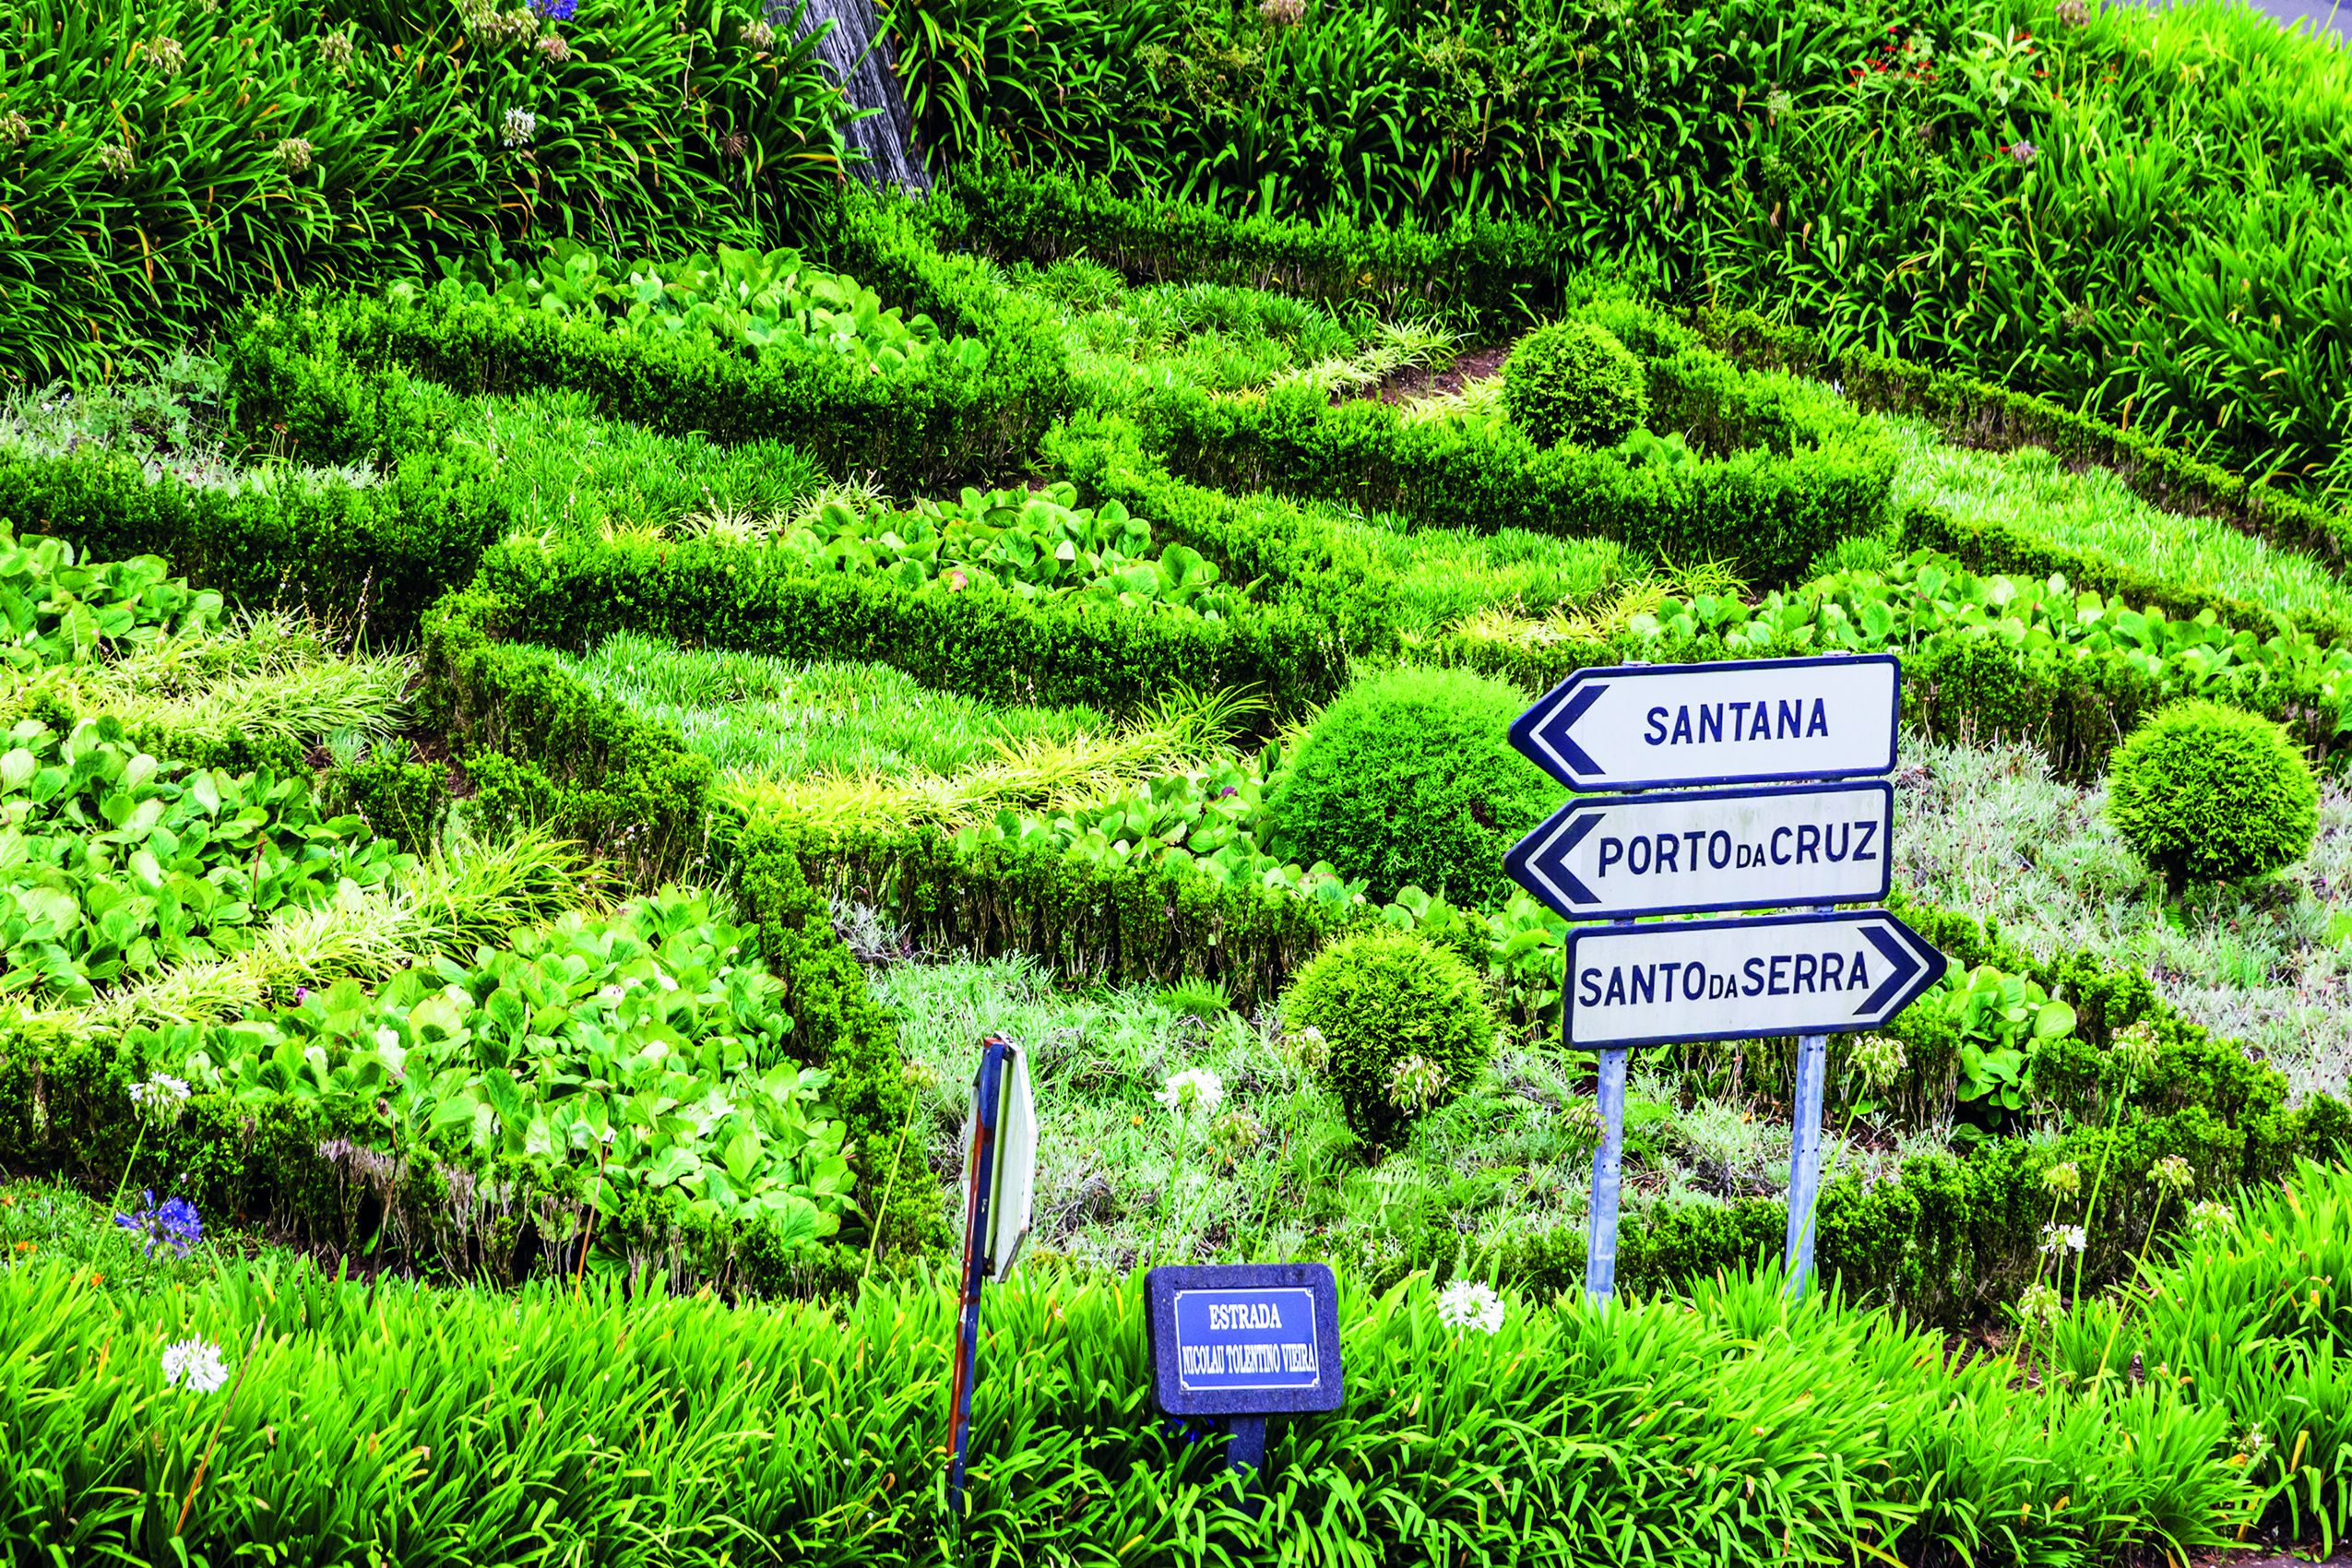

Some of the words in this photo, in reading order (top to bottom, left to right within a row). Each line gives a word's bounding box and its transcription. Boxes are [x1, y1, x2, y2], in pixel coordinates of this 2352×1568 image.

[1644, 697, 1829, 746] SANTANA
[1598, 829, 1732, 878] PORTO
[1735, 842, 1767, 870] DA
[1769, 820, 1879, 866] CRUZ
[1578, 961, 1706, 1007] SANTO
[1708, 973, 1739, 1000] DA
[1740, 950, 1870, 997] SERRA
[1208, 1302, 1282, 1330] ESTRADA
[1182, 1344, 1225, 1375] NICOLAU
[1225, 1344, 1281, 1374] TOLENTINO
[1280, 1342, 1316, 1373] VIEIRA
